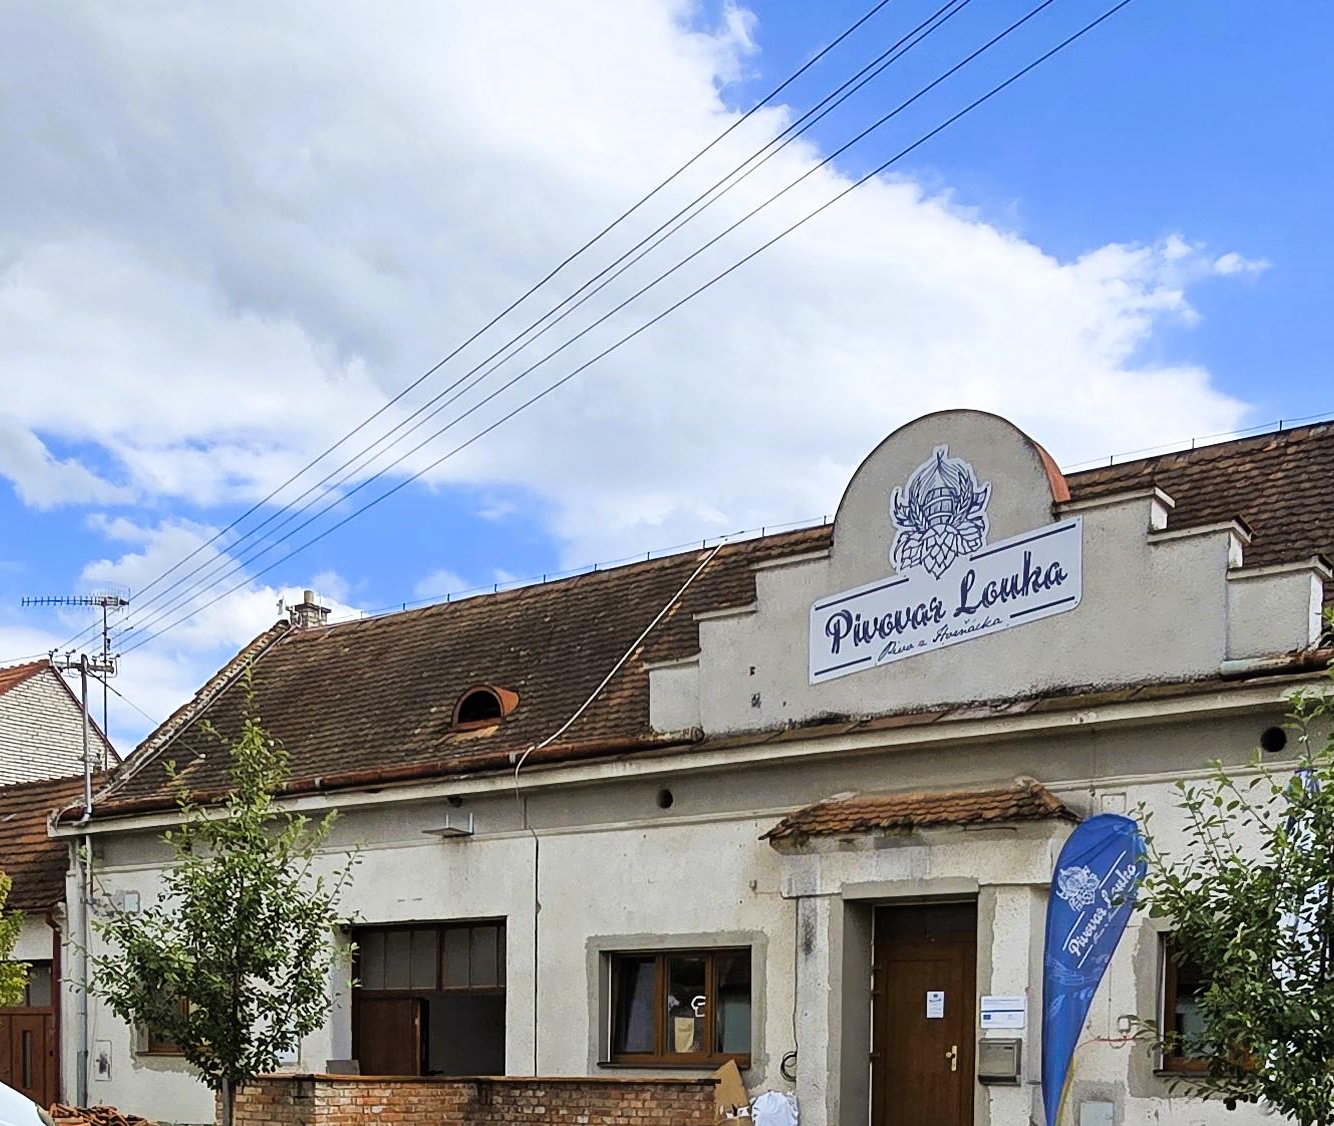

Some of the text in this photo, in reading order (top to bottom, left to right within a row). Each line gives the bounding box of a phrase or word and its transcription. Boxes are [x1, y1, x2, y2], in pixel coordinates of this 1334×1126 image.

[825, 550, 1067, 654] Pivovar Louka
[1068, 907, 1108, 957] Pivovar
